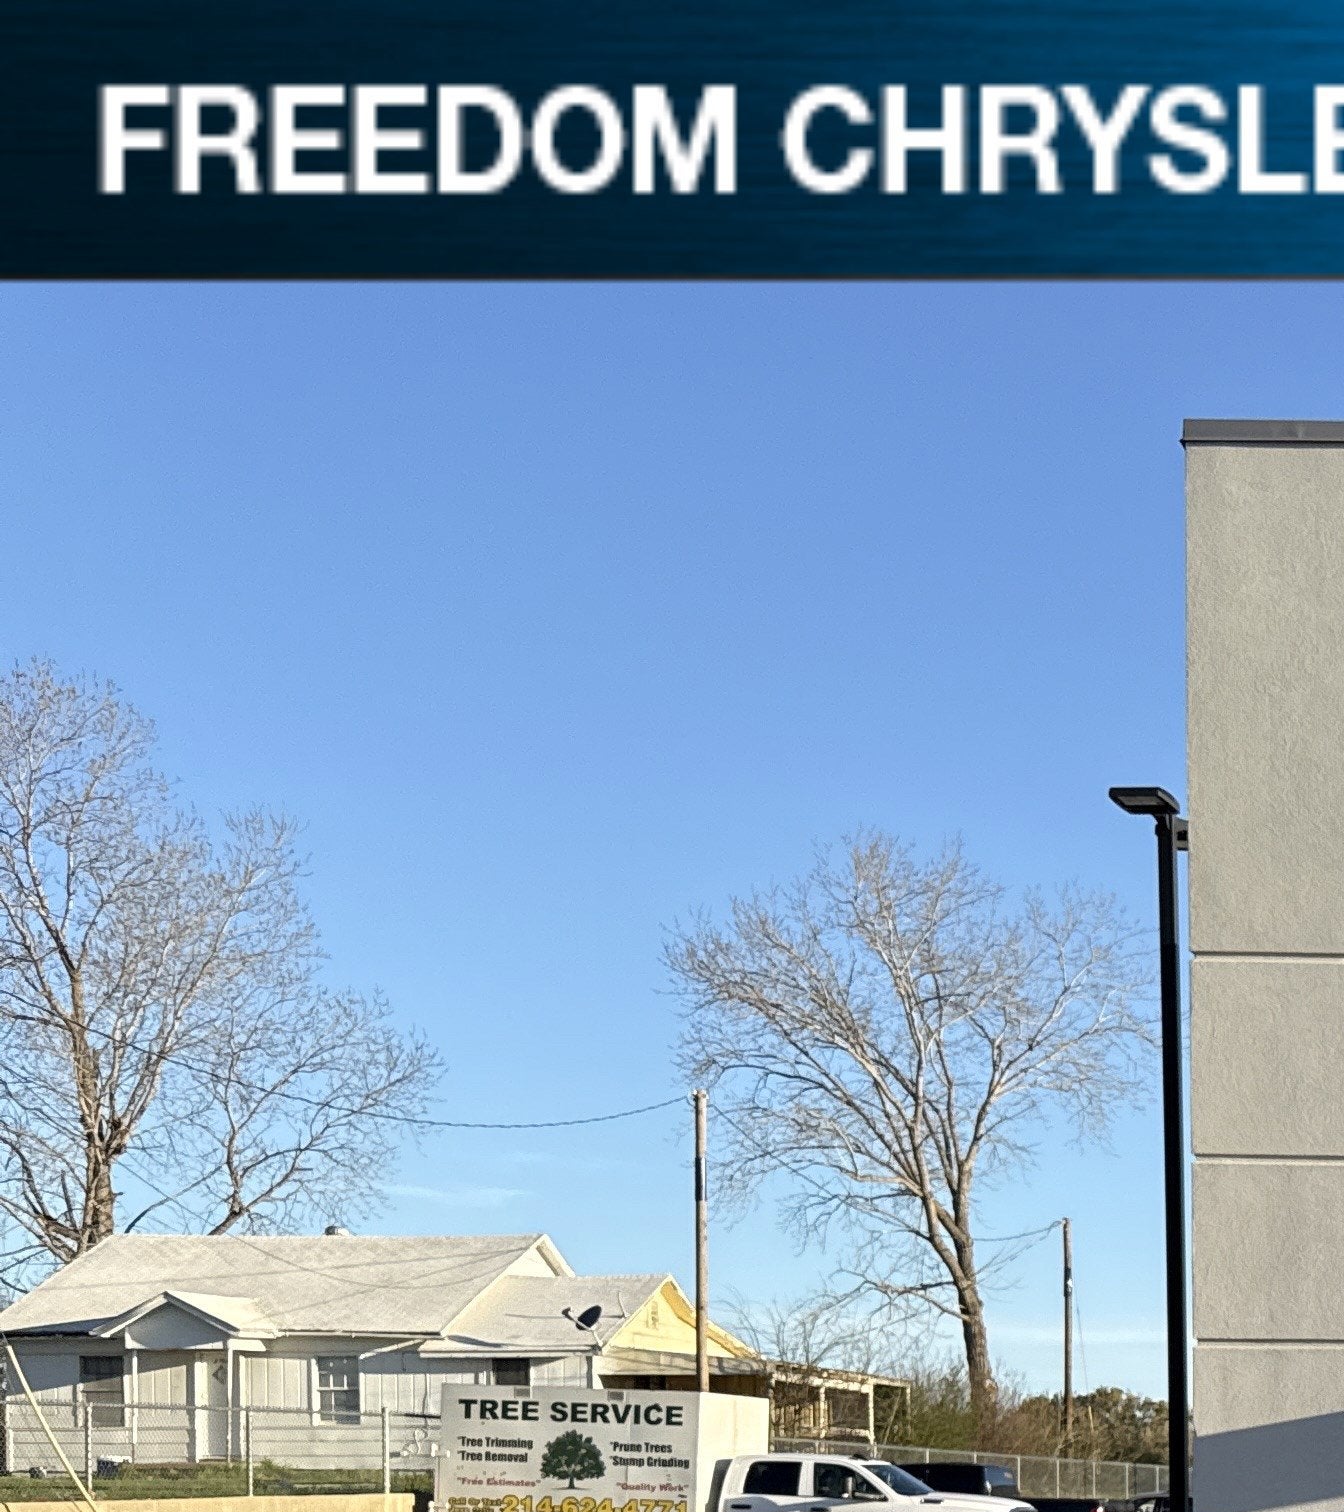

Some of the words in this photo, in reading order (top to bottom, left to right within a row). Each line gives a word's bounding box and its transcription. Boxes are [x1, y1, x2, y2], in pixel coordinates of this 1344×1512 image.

[458, 1398, 540, 1421] TREE
[549, 1401, 684, 1427] SERVICE
[485, 1436, 534, 1450] Trimming
[644, 1442, 673, 1454] Trees
[485, 1450, 529, 1463] Removal
[646, 1456, 690, 1469] Grinding
